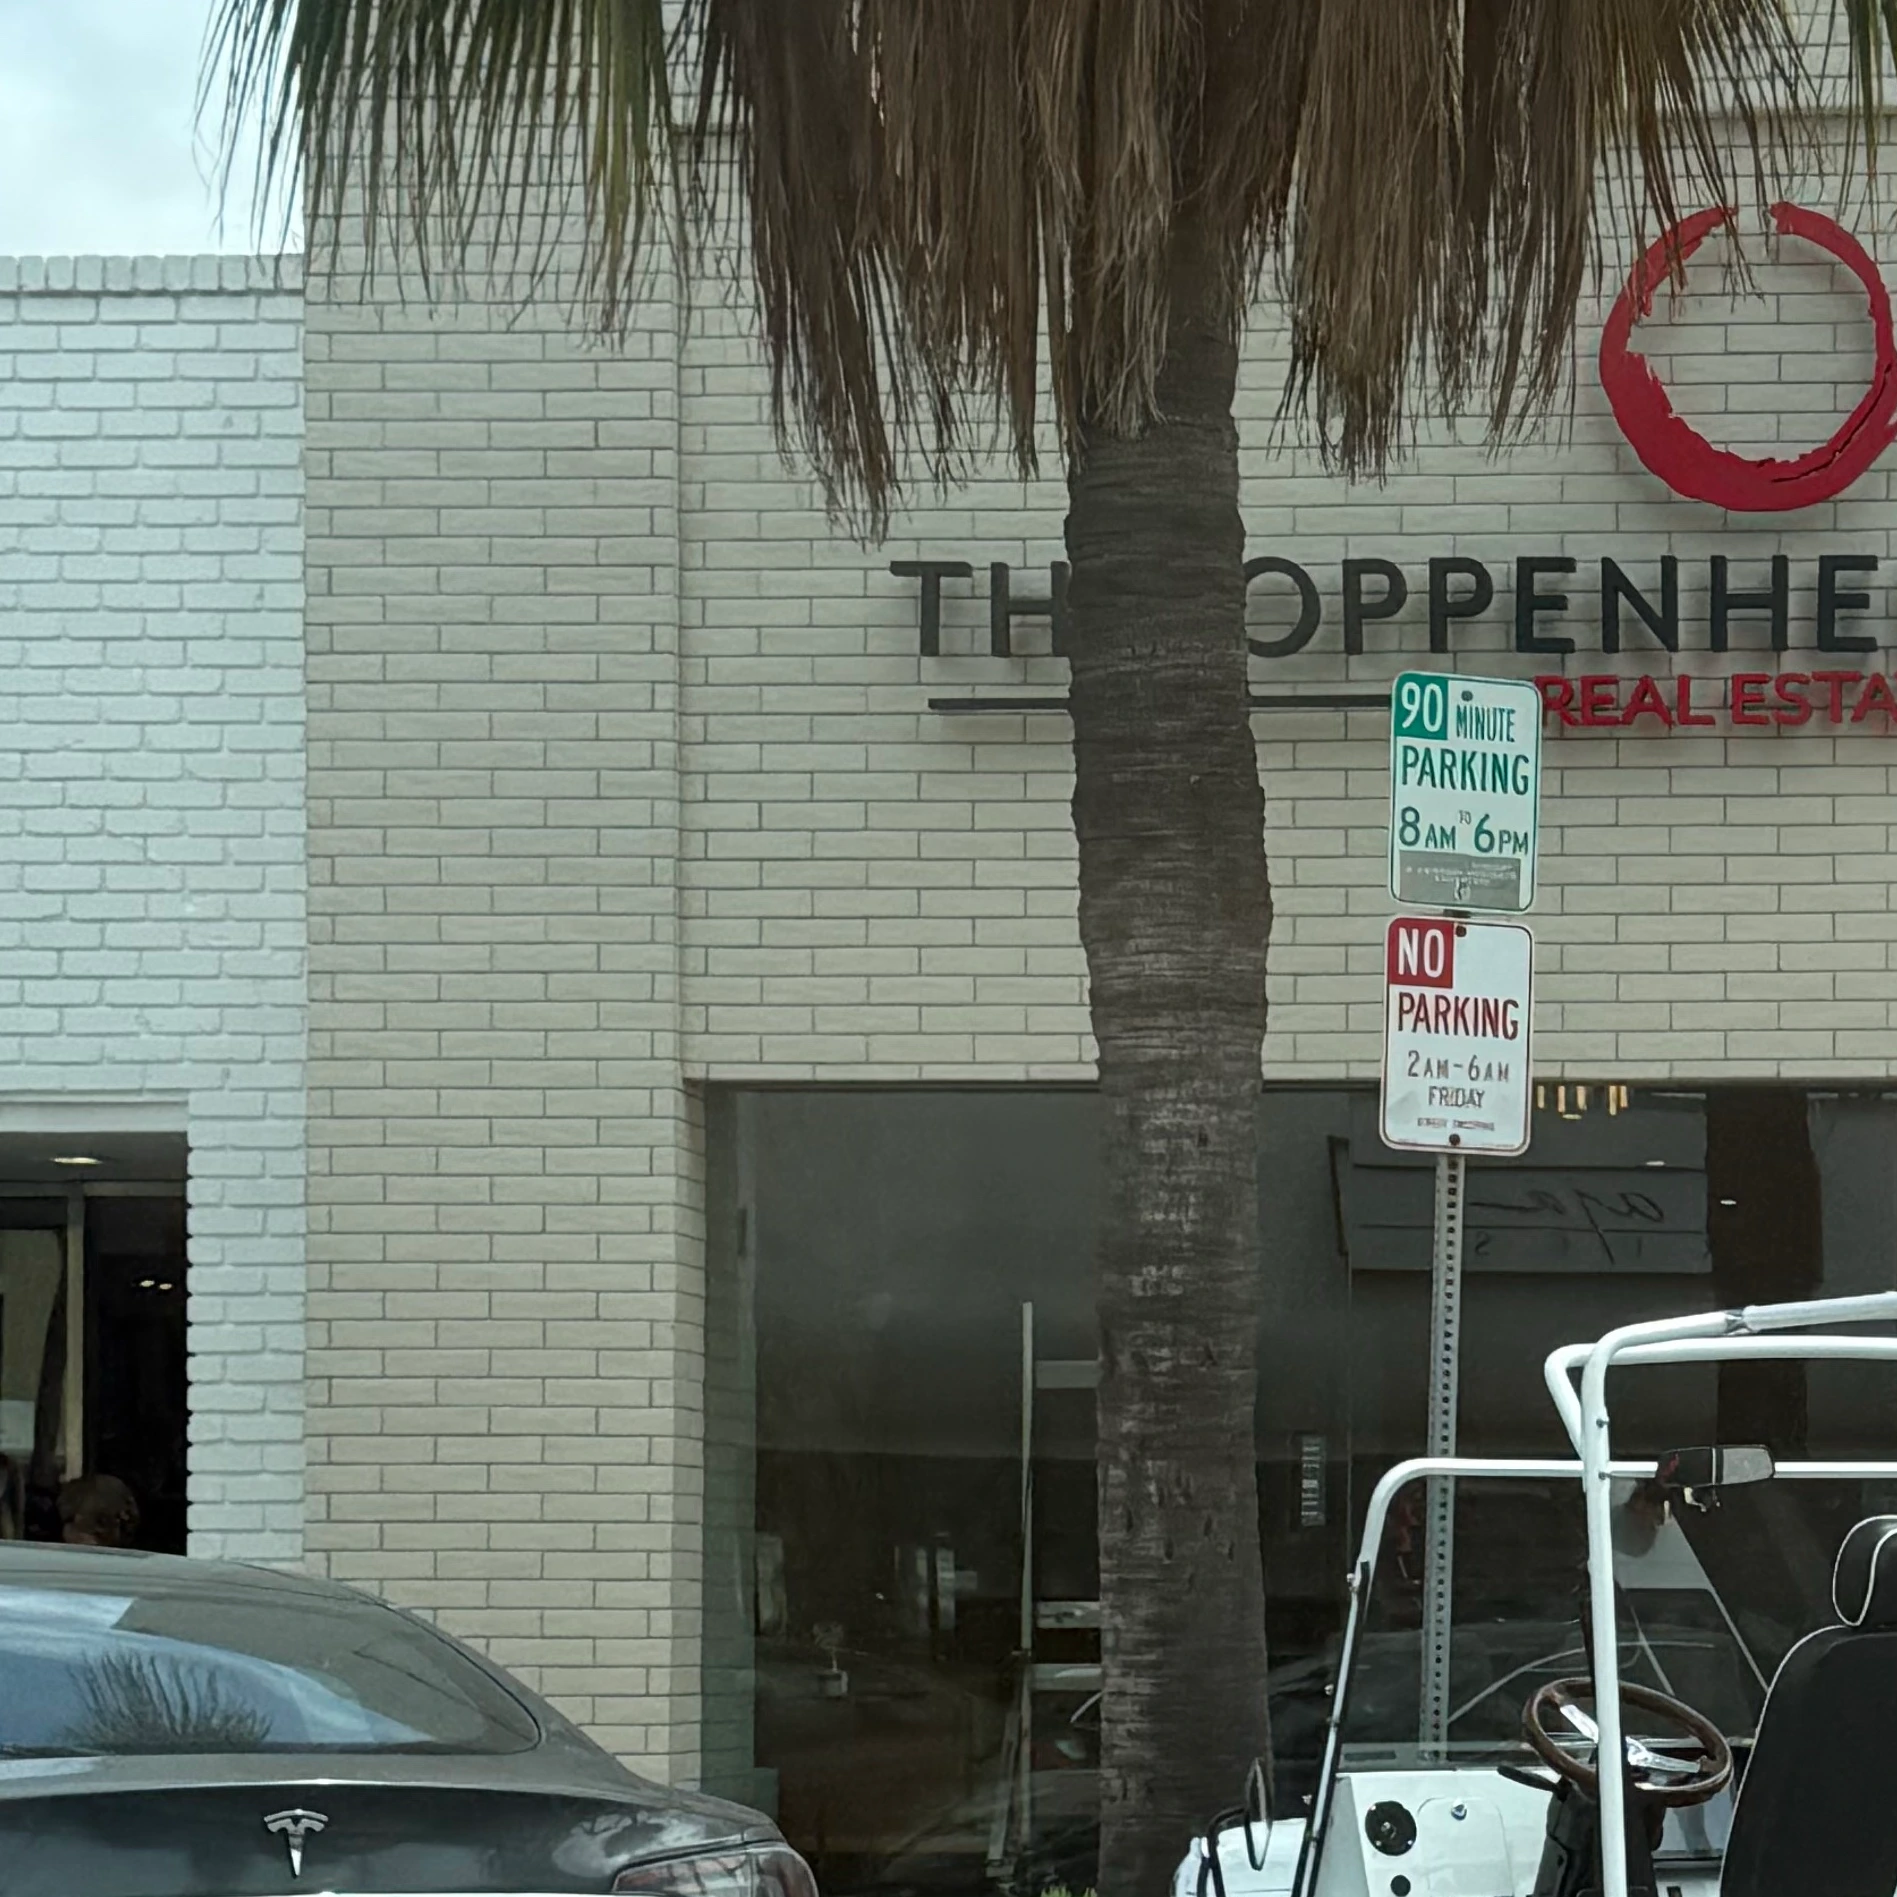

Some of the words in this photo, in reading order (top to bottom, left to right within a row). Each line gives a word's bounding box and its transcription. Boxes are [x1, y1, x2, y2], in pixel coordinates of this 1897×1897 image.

[890, 560, 1070, 657] TH
[1402, 682, 1443, 733] 90
[1456, 704, 1516, 742] MINUTE
[1536, 674, 1716, 727] REAL
[1402, 745, 1530, 796] PARKING
[1398, 927, 1445, 978] NO
[1397, 992, 1520, 1041] PARKING
[1428, 1086, 1485, 1109] FRIDAY
